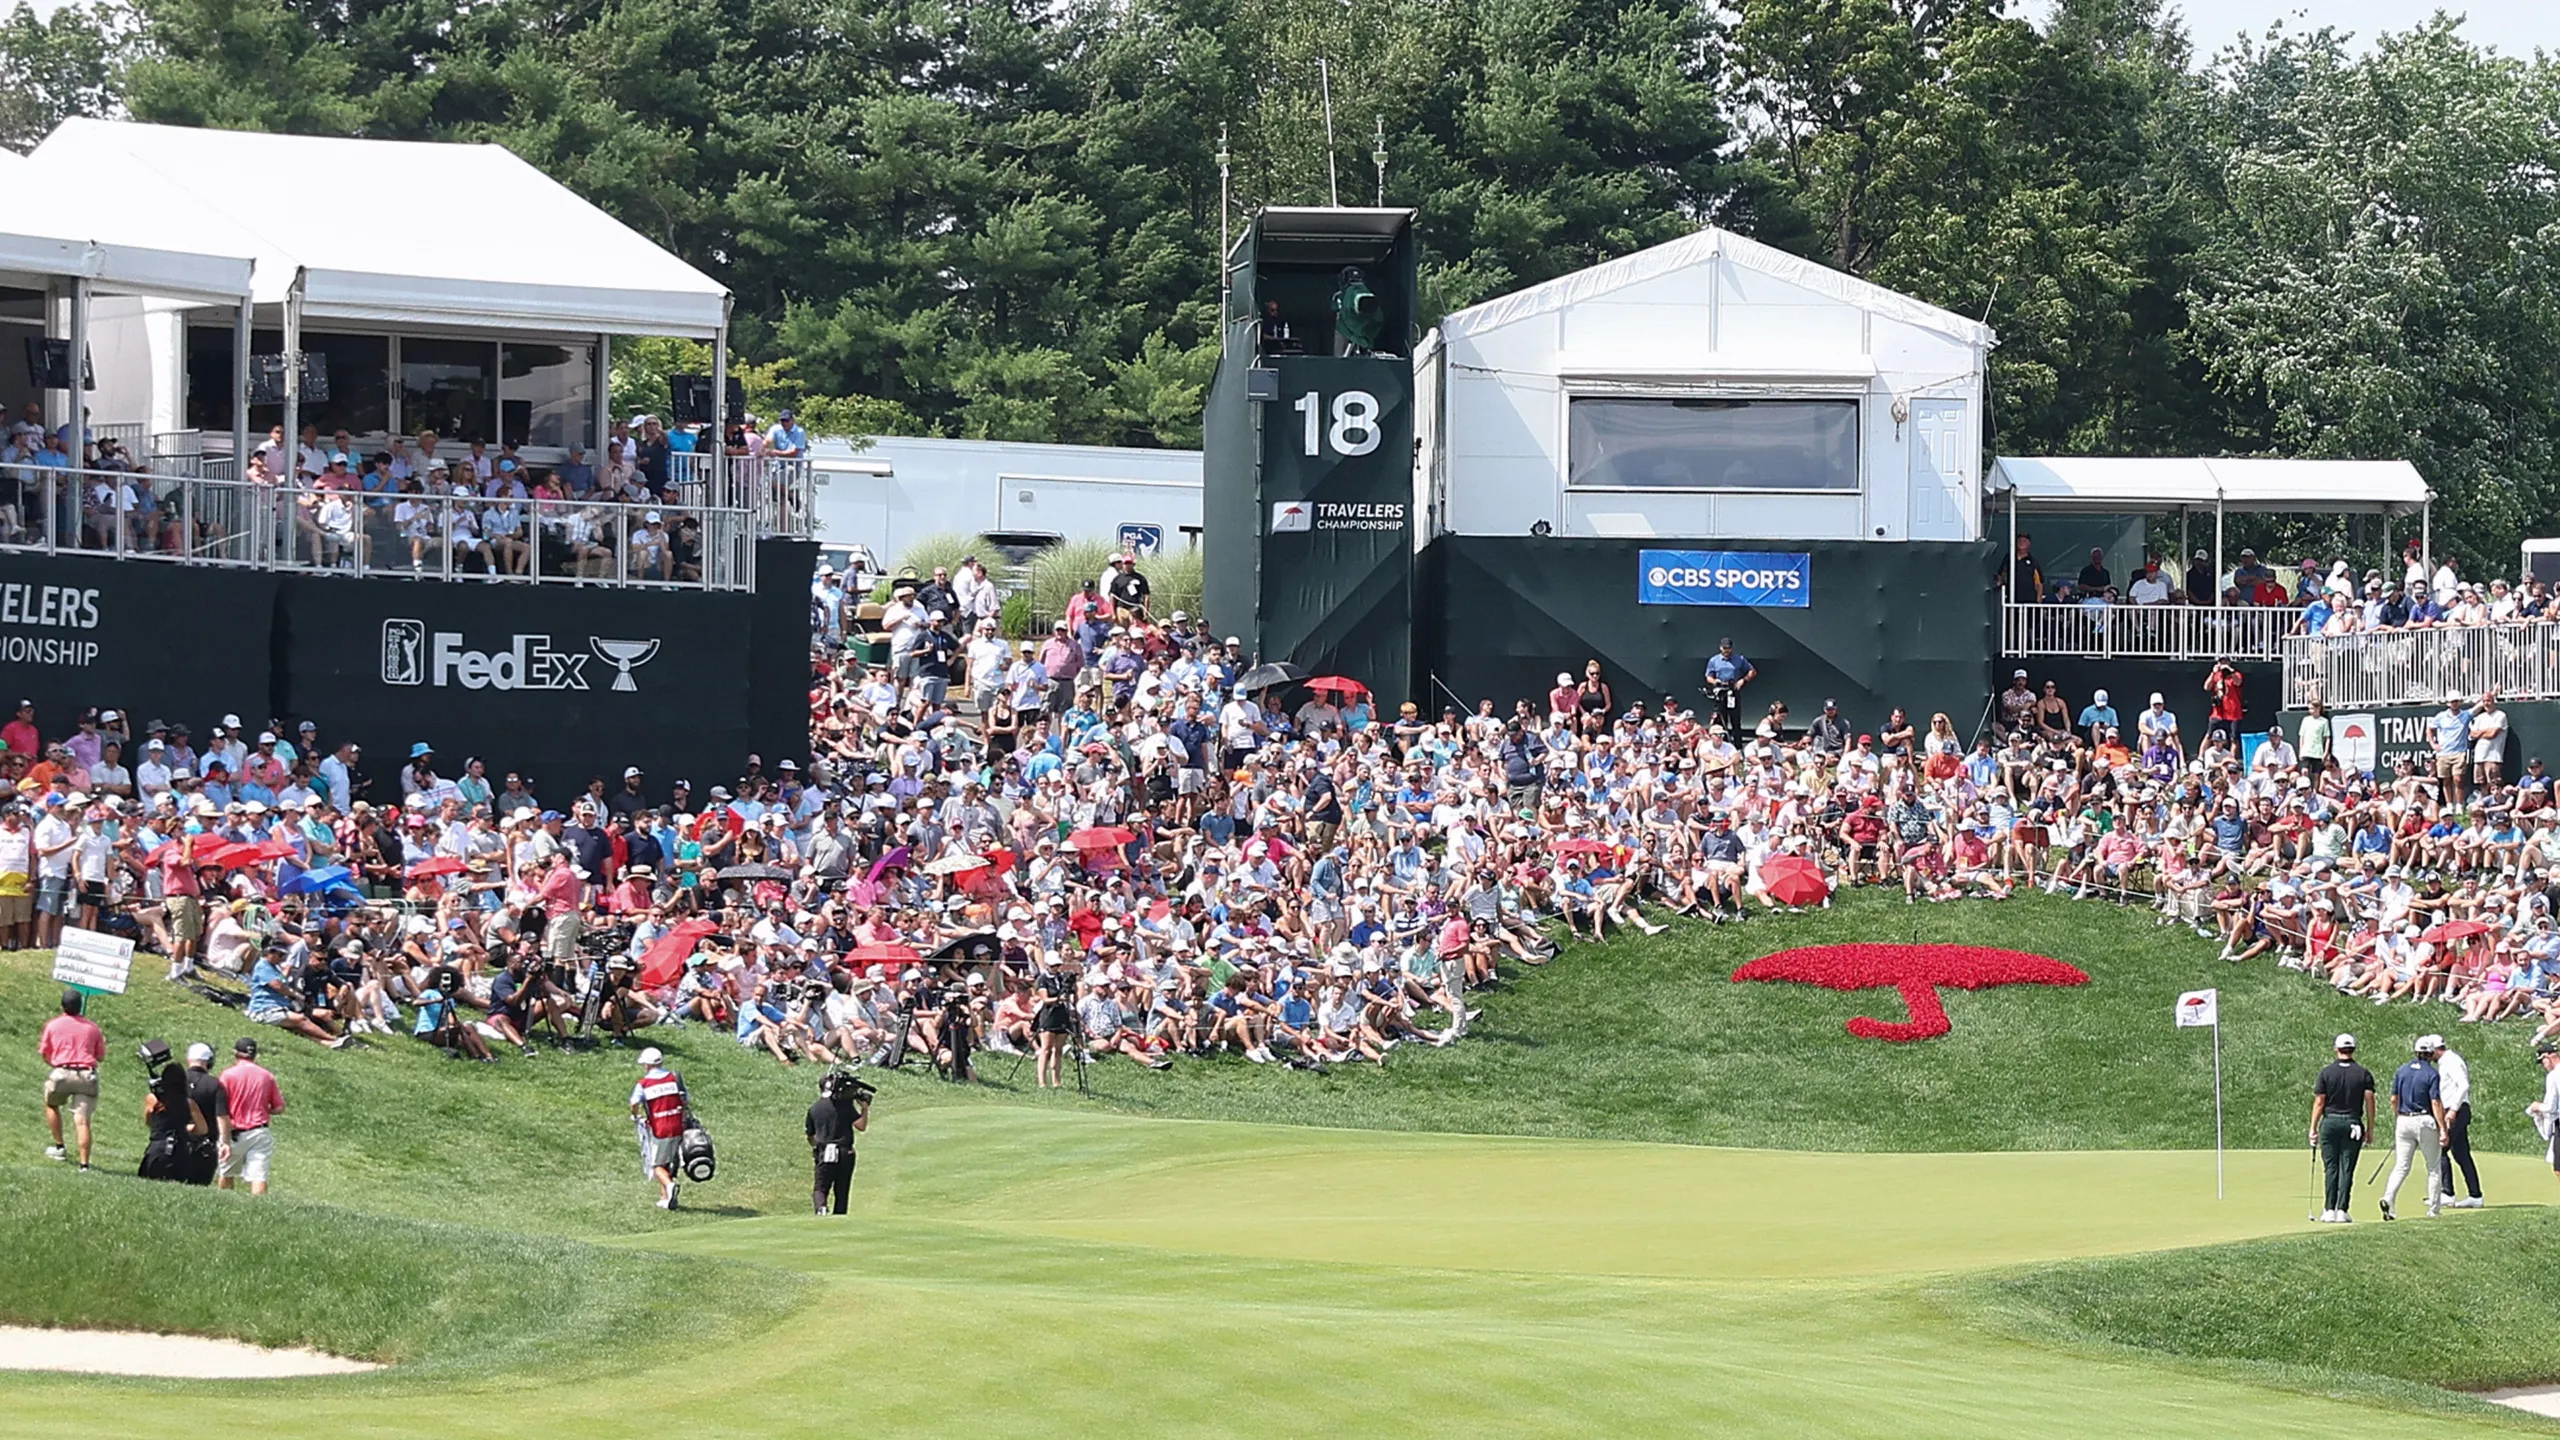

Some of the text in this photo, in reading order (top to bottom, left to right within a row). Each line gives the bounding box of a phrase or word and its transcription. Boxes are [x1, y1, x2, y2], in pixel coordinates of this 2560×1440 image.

[1294, 390, 1382, 457] 18
[1317, 503, 1405, 518] TRAVELERS
[1122, 531, 1144, 541] PGA
[1316, 519, 1405, 531] CHAMPIONSHIP
[1668, 567, 1801, 590] CBS SPORTS
[0, 582, 100, 629] ELERS
[0, 636, 100, 667] IONSHIP
[433, 631, 591, 691] FedEx
